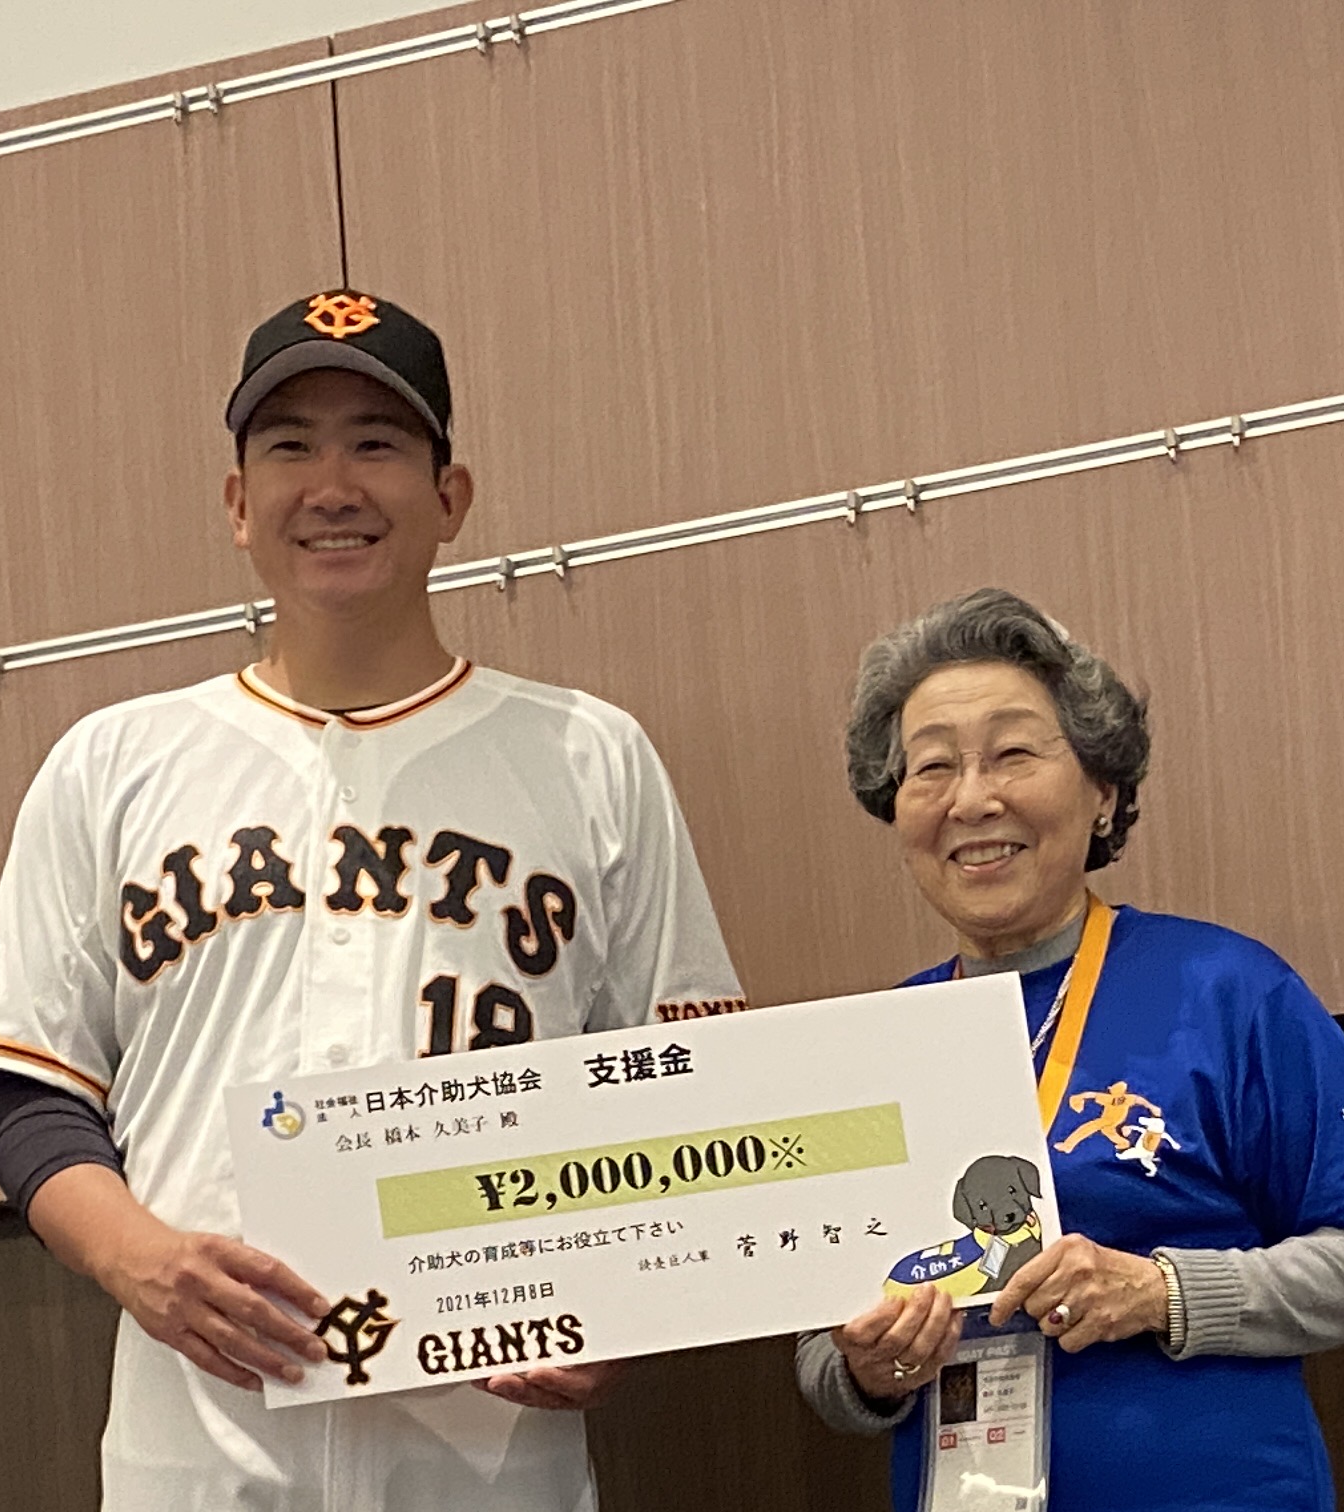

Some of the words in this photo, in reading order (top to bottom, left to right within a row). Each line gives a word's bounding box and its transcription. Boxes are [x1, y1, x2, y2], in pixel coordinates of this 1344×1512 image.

[119, 825, 577, 984] GIANTS
[365, 1067, 543, 1114] 日本介助犬協会
[583, 1043, 694, 1088] 支援金
[335, 1131, 372, 1153] 会長
[434, 1115, 487, 1138] 久美子
[408, 1220, 684, 1274] 介助犬の育成等にお役立て下さい
[910, 1253, 965, 1280] 介助犬
[436, 1281, 555, 1314] 2021年12月8日
[416, 1313, 585, 1375] GIANTS
